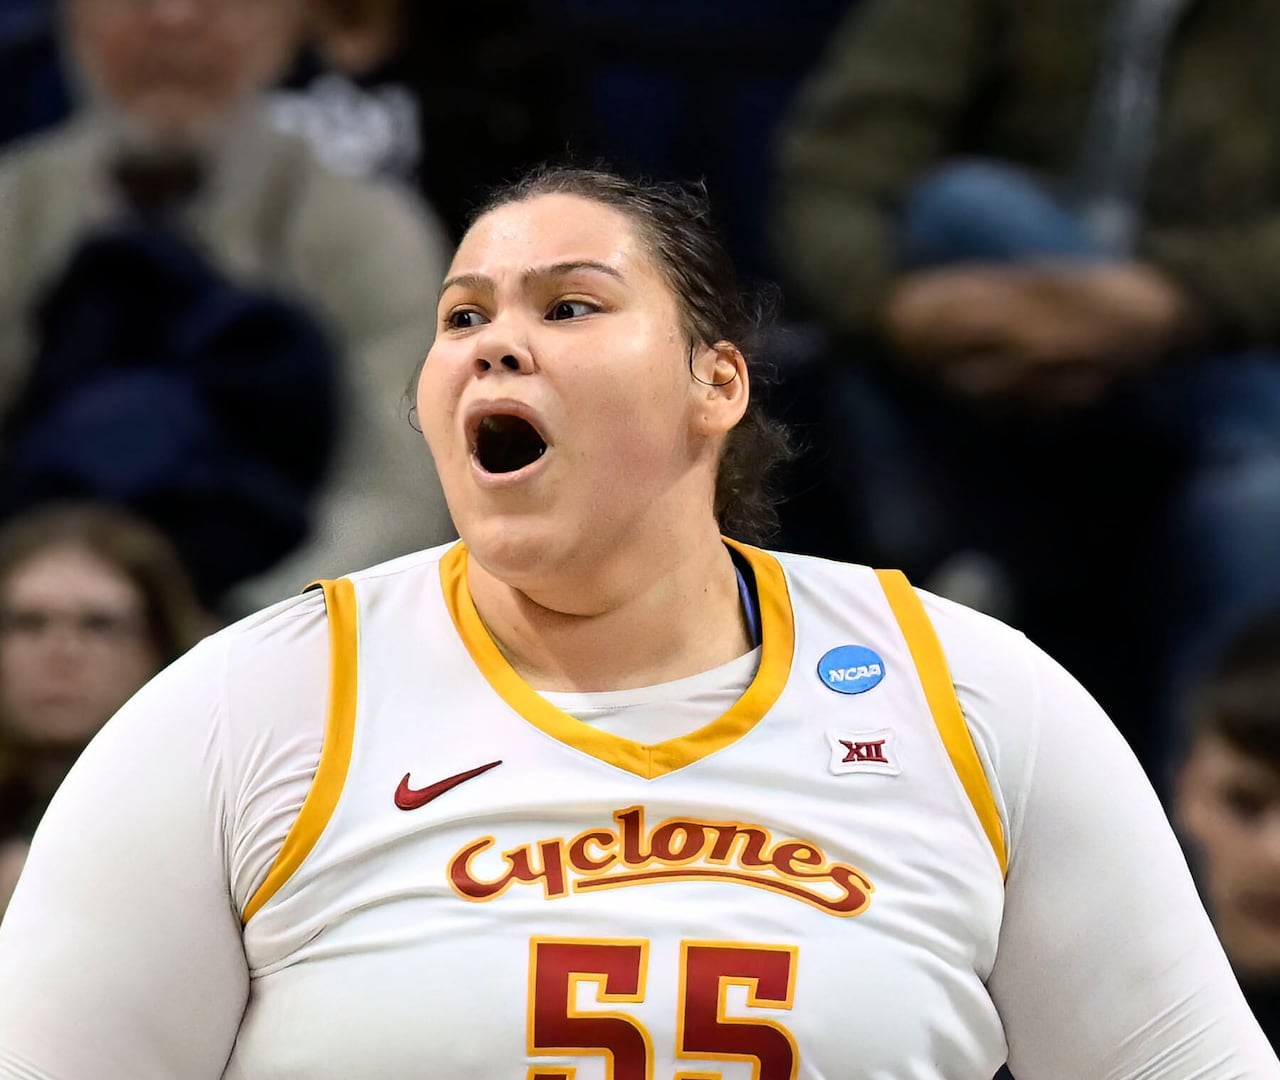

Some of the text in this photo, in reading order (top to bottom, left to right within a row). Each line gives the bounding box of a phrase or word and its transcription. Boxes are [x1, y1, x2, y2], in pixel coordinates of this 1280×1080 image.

[828, 663, 882, 683] NCAA
[838, 738, 889, 763] XII
[447, 804, 875, 918] Cyclones
